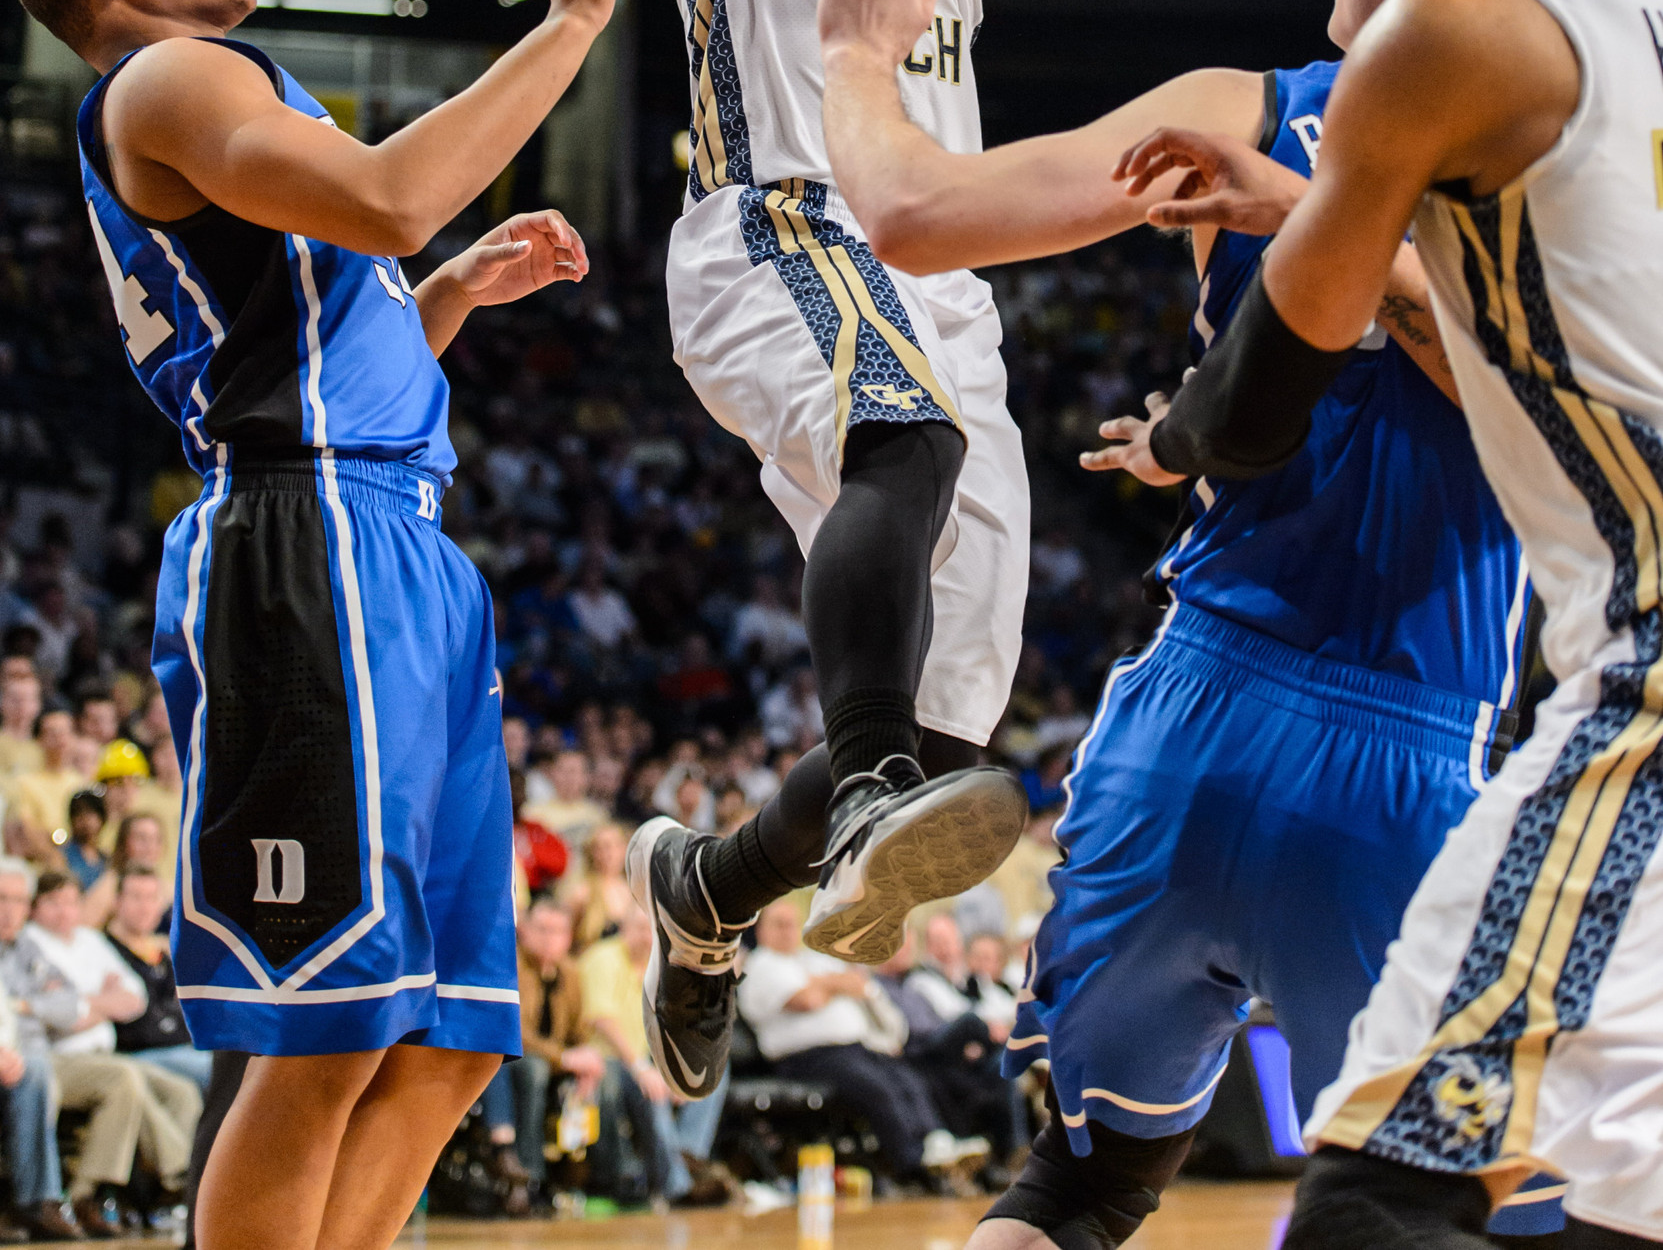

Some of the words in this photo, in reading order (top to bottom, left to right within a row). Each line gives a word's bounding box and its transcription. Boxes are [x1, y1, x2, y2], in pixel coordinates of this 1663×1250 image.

[900, 14, 963, 86] CH
[859, 383, 924, 410] GT
[416, 479, 437, 522] D
[249, 838, 305, 904] D
